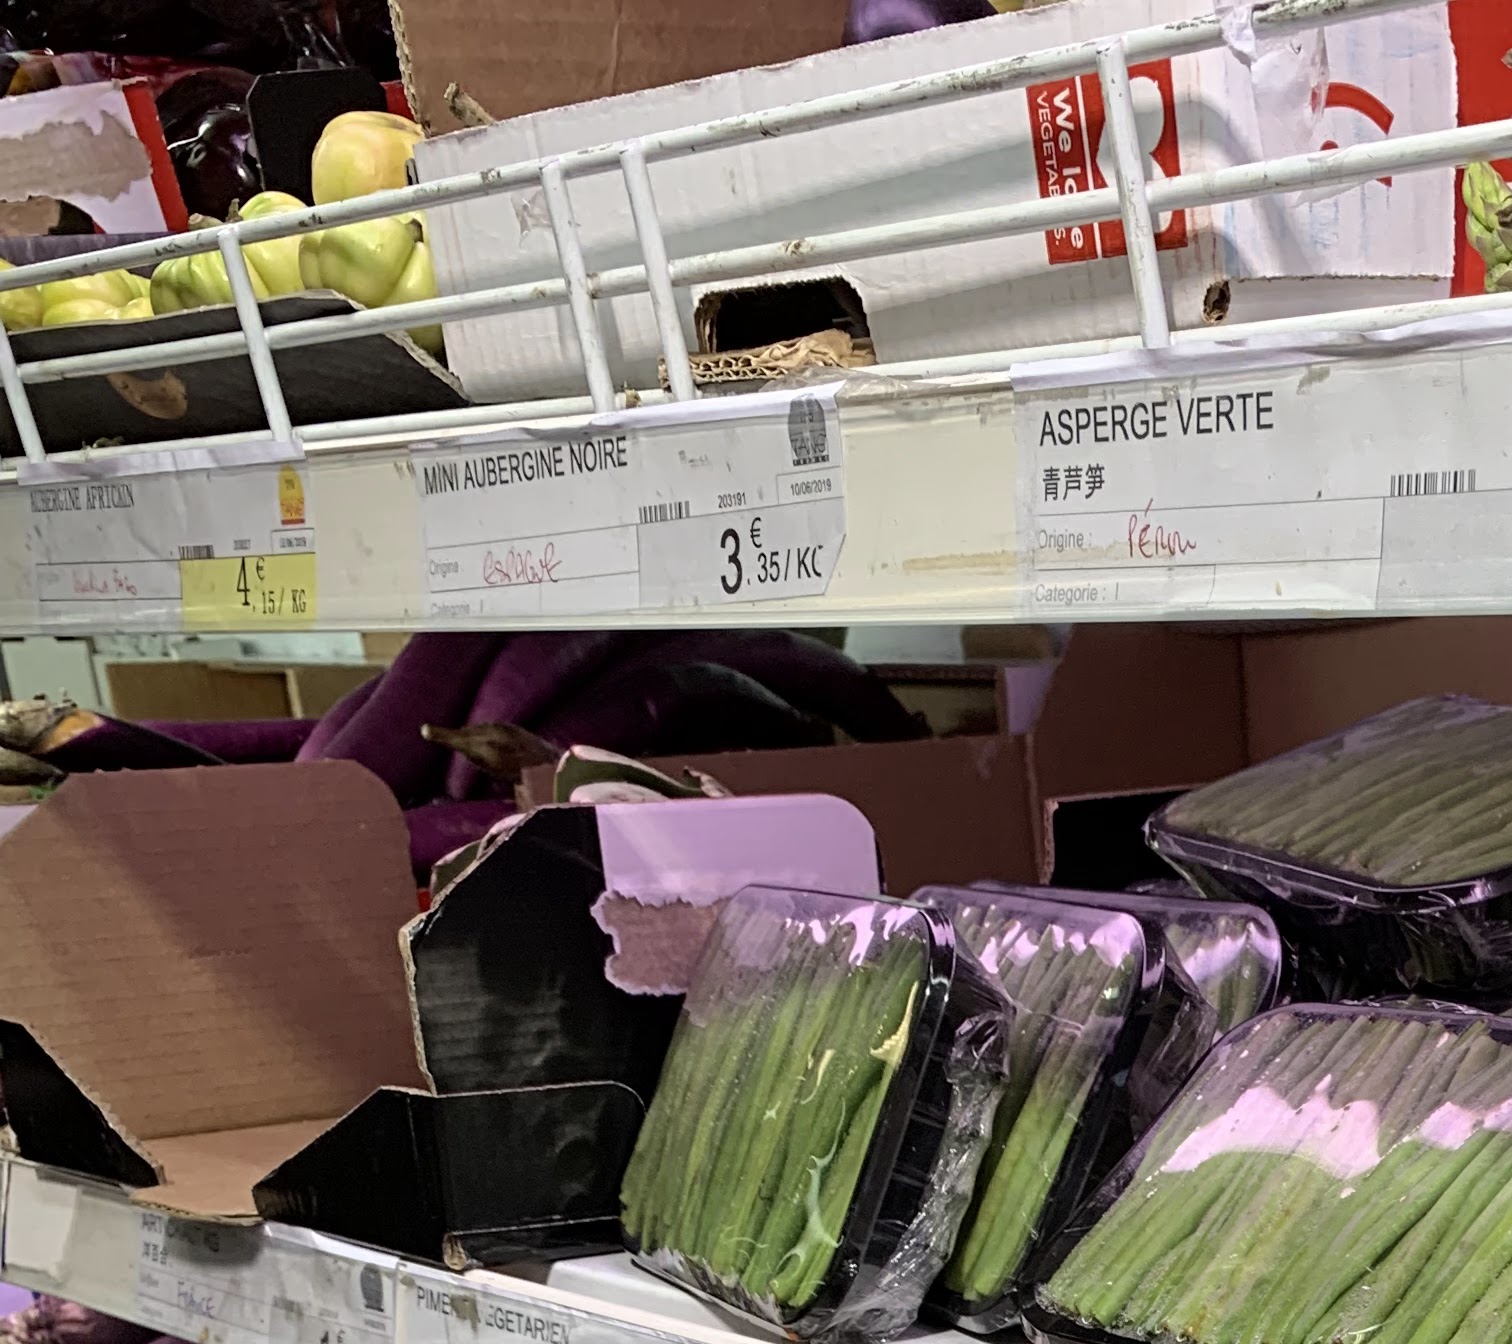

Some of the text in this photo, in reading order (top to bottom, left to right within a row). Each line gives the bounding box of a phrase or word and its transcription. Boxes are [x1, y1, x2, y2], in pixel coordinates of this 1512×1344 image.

[1036, 90, 1066, 246] VEGETABS.
[1052, 87, 1085, 249] We loe
[1039, 391, 1274, 446] ASPERGE VERTE
[424, 436, 628, 495] MINI AUBERGINE NOIRE
[790, 478, 831, 496] 10/06/2019
[1043, 463, 1105, 501] 青芦笋
[718, 492, 747, 509] 203191
